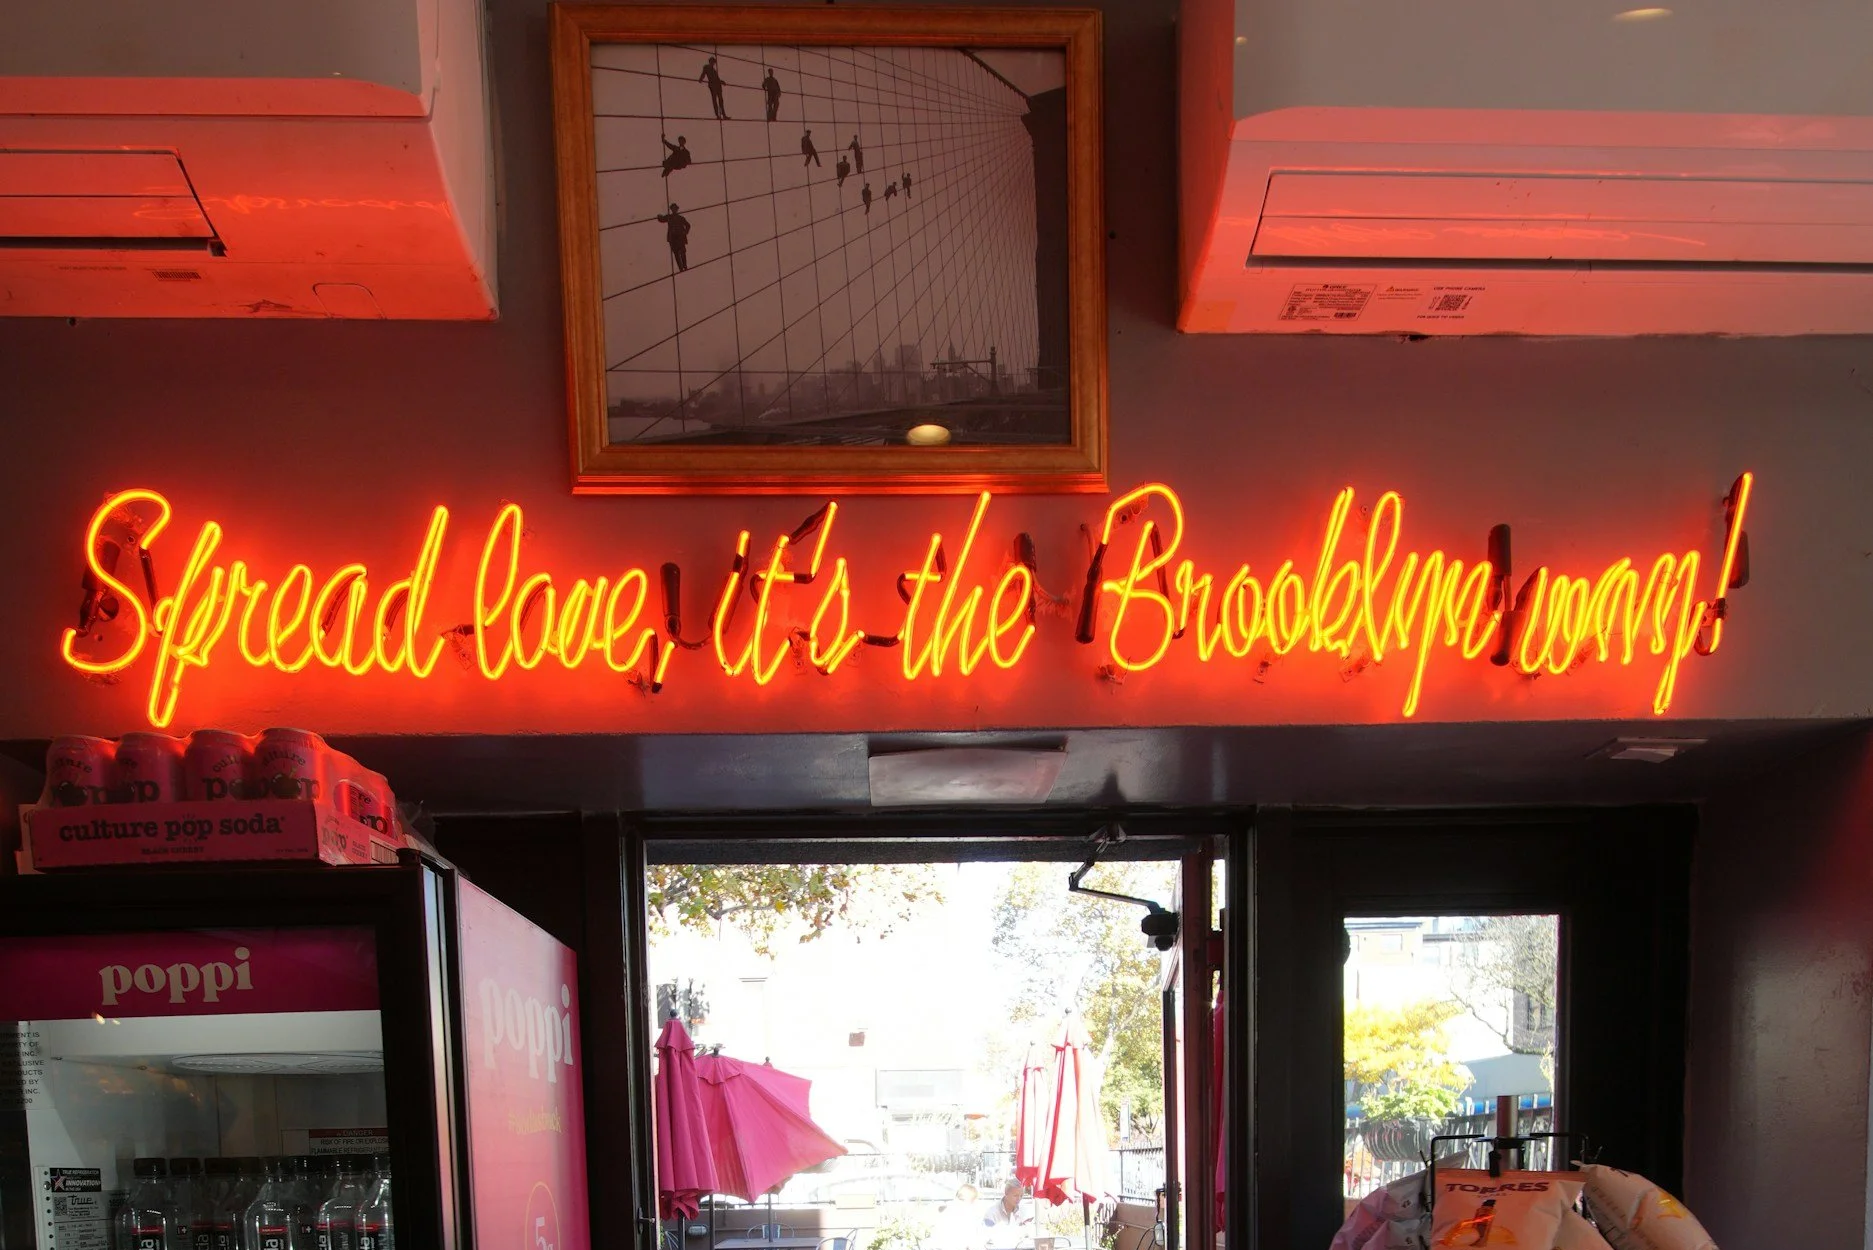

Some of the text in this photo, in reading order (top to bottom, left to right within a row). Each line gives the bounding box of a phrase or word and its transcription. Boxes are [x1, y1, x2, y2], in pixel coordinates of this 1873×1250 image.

[62, 471, 1754, 728] Spread love, it's the Brooklyn way!
[58, 814, 282, 843] culture pop soda
[98, 946, 254, 1006] poppi
[479, 977, 574, 1084] poppi
